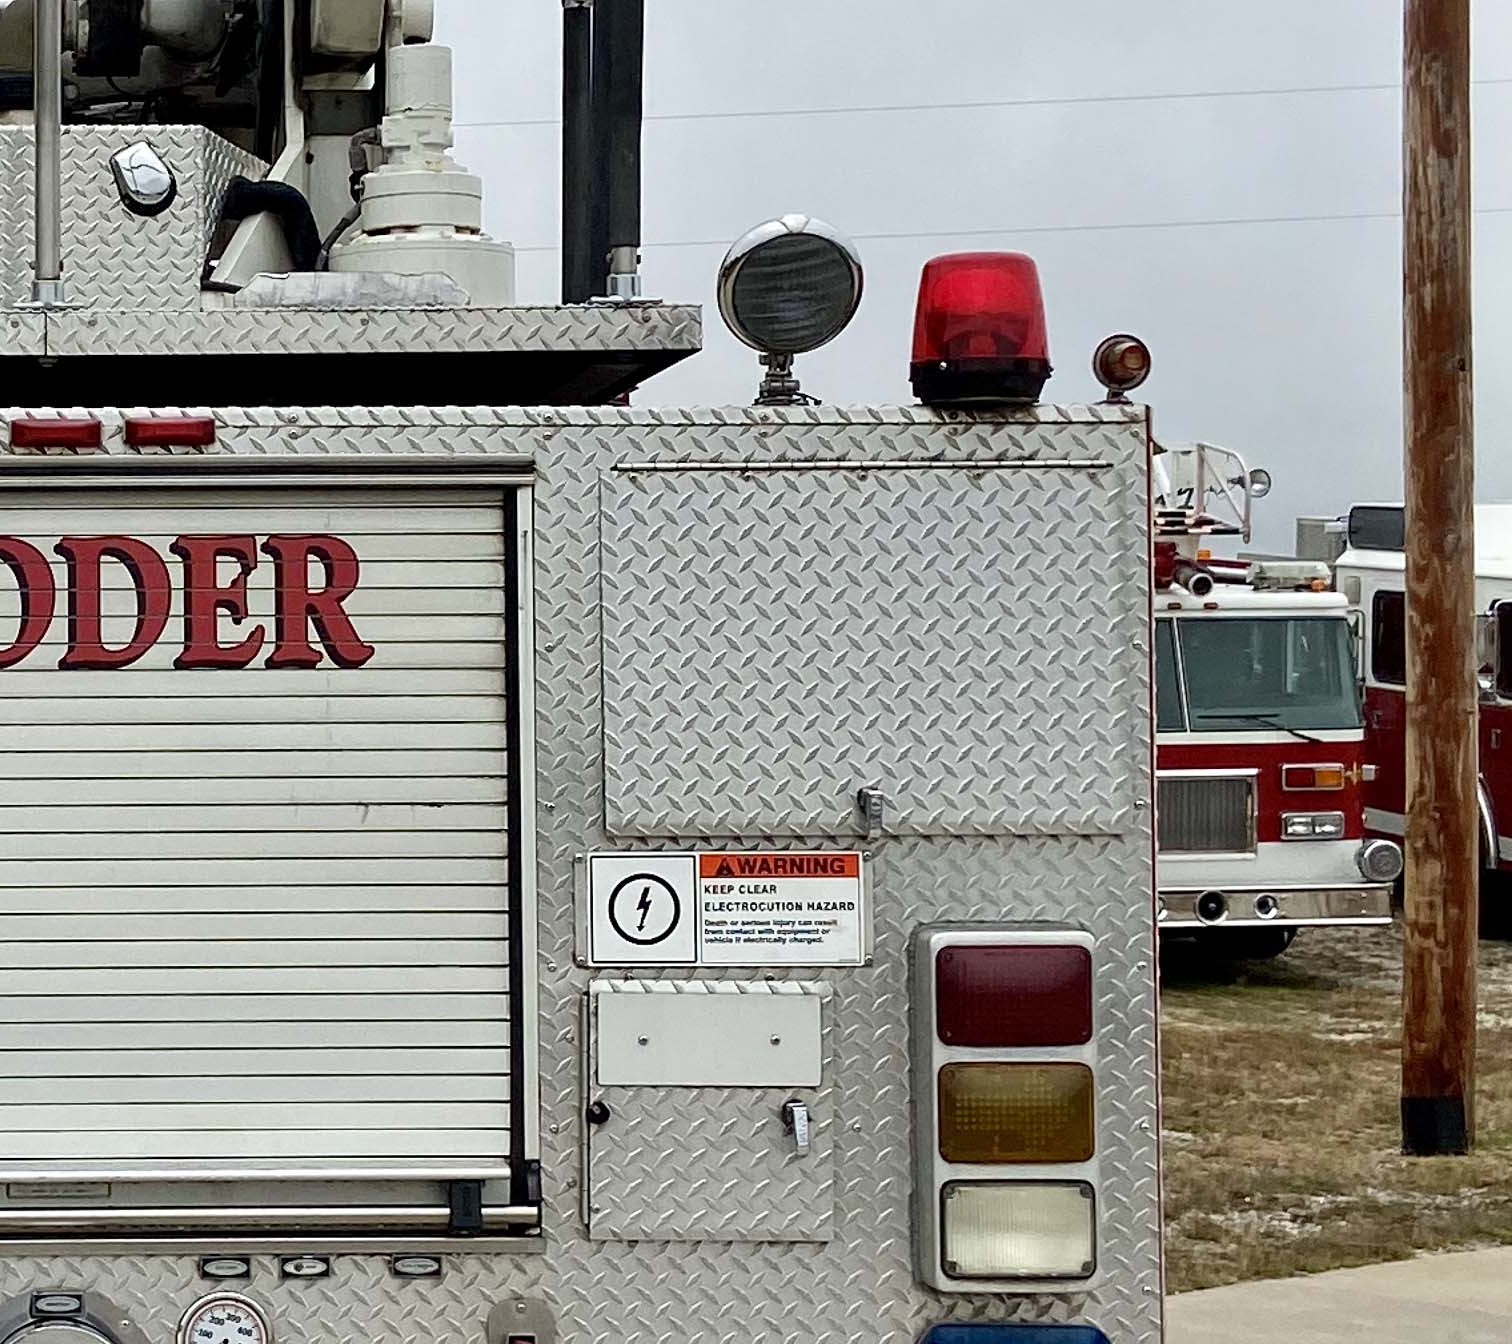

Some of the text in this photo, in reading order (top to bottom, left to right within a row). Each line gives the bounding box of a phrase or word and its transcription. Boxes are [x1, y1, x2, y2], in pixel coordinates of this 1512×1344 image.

[737, 857, 846, 875] WARNING
[704, 884, 778, 895] KEEP CLEAR
[704, 901, 856, 912] ELECTROCUTION HAZARD
[772, 920, 796, 928] injury
[705, 936, 733, 944] vehicle
[743, 936, 787, 945] electrically
[209, 1315, 225, 1326] 200
[226, 1312, 242, 1324] 300
[198, 1327, 214, 1339] 100
[237, 1326, 253, 1337] 400
